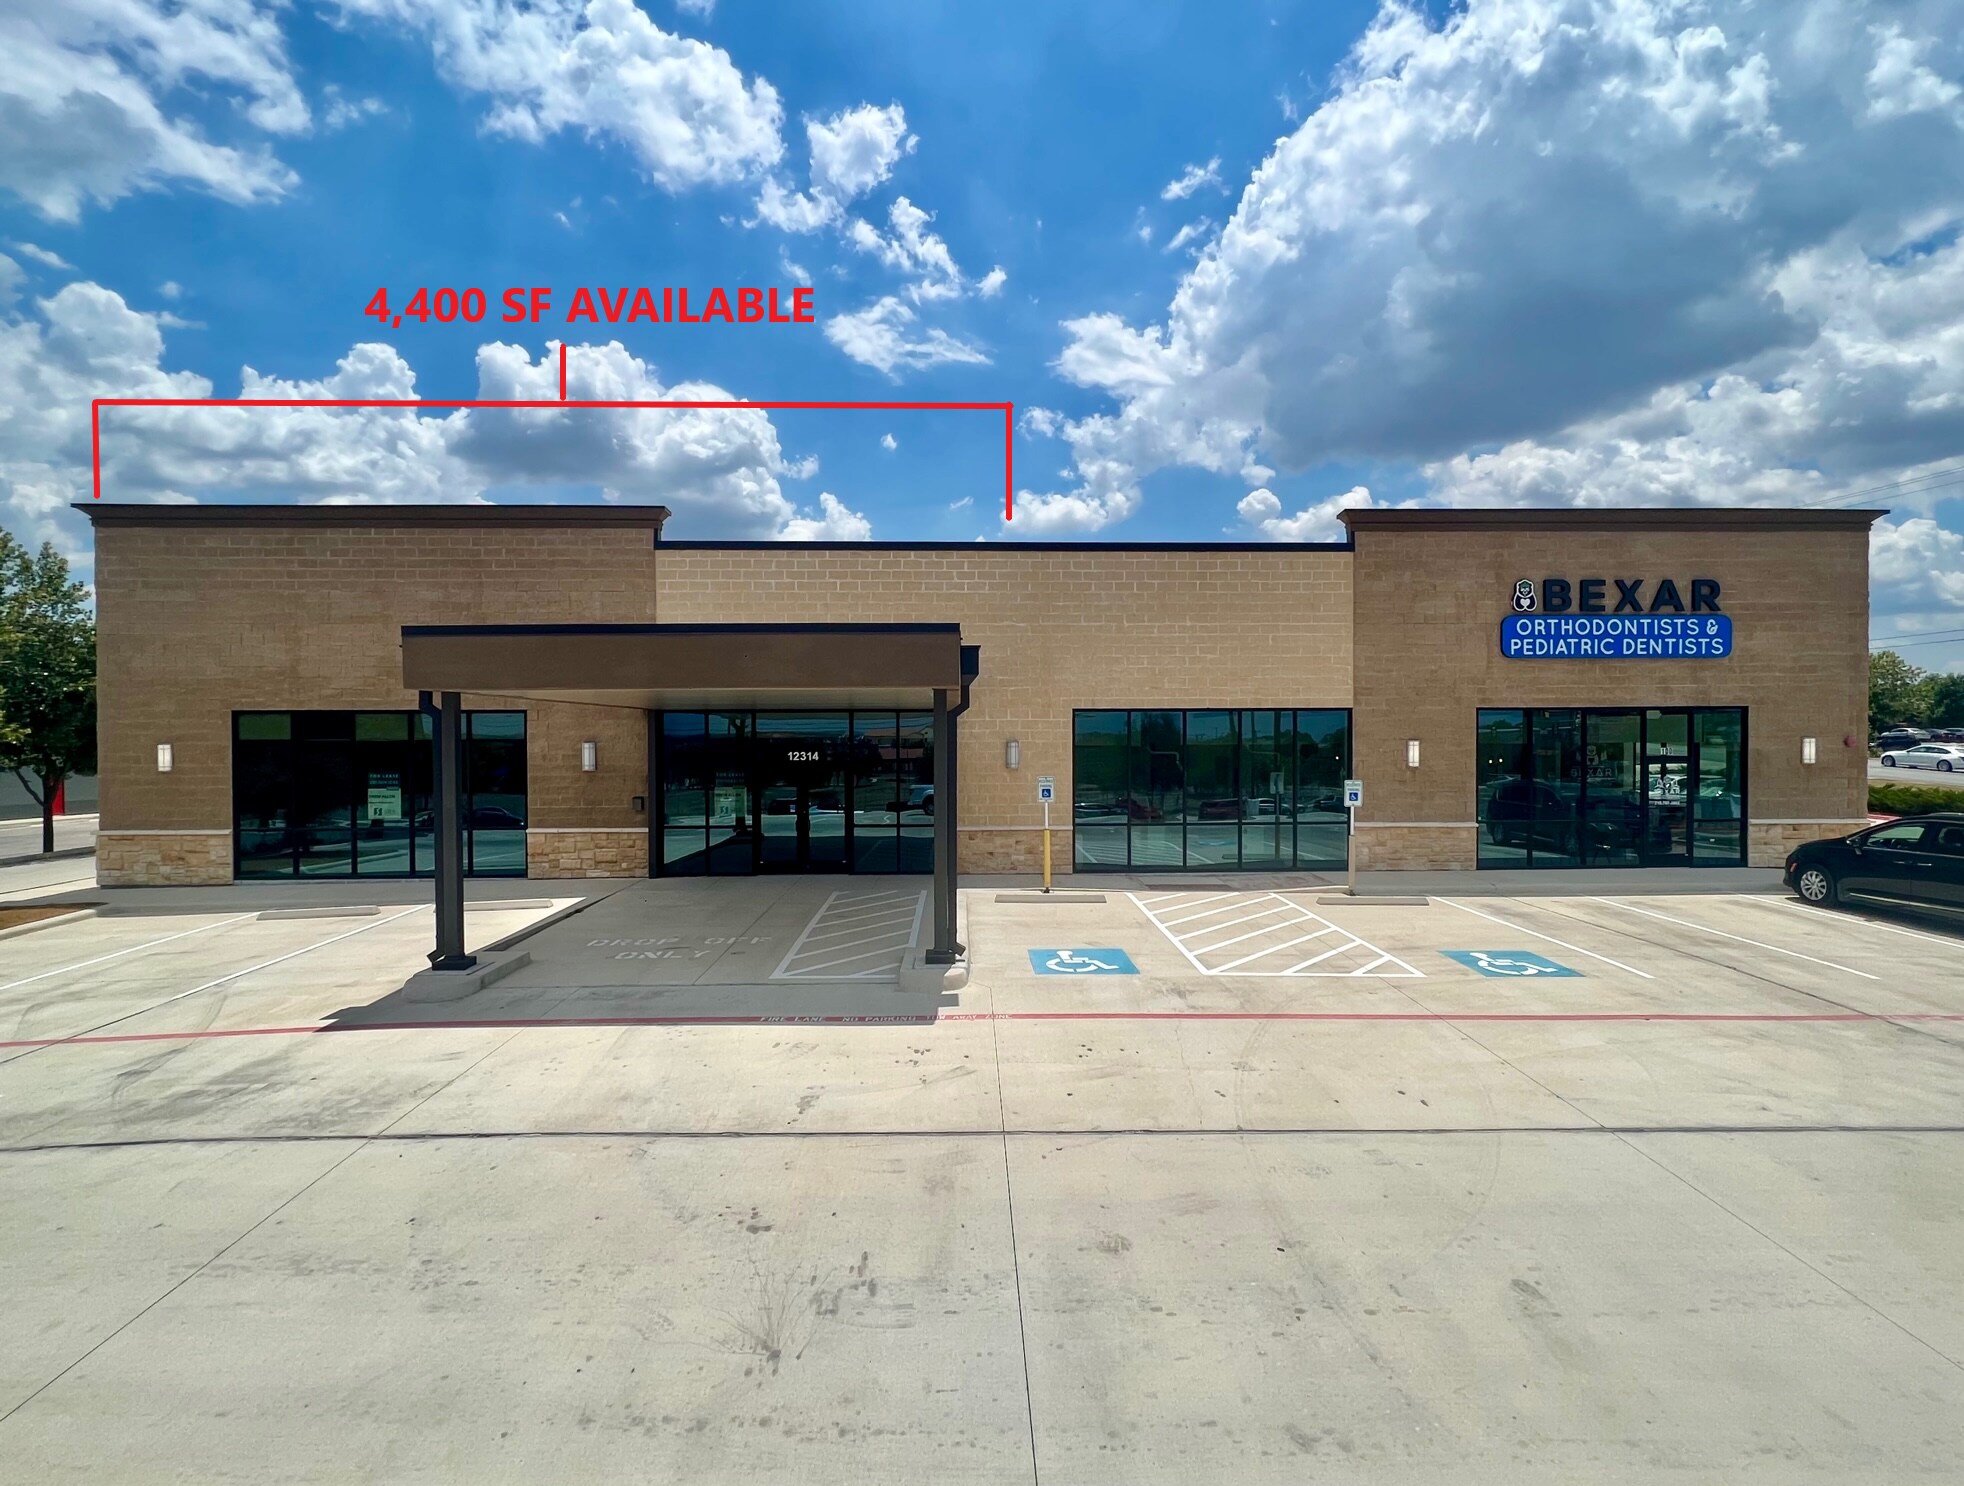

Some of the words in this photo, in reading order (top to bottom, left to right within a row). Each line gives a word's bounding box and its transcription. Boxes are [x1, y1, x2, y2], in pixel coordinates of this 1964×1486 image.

[1543, 579, 1722, 612] BEXAR
[1516, 618, 1700, 636] ORTHODONTISTS
[1706, 619, 1719, 636] &
[1510, 638, 1615, 656] PEDIATRIC
[1623, 638, 1724, 656] DENTISTS
[787, 751, 820, 761] 12314
[586, 937, 680, 947] DROP
[703, 936, 773, 945] OFF
[614, 950, 712, 960] ONLY
